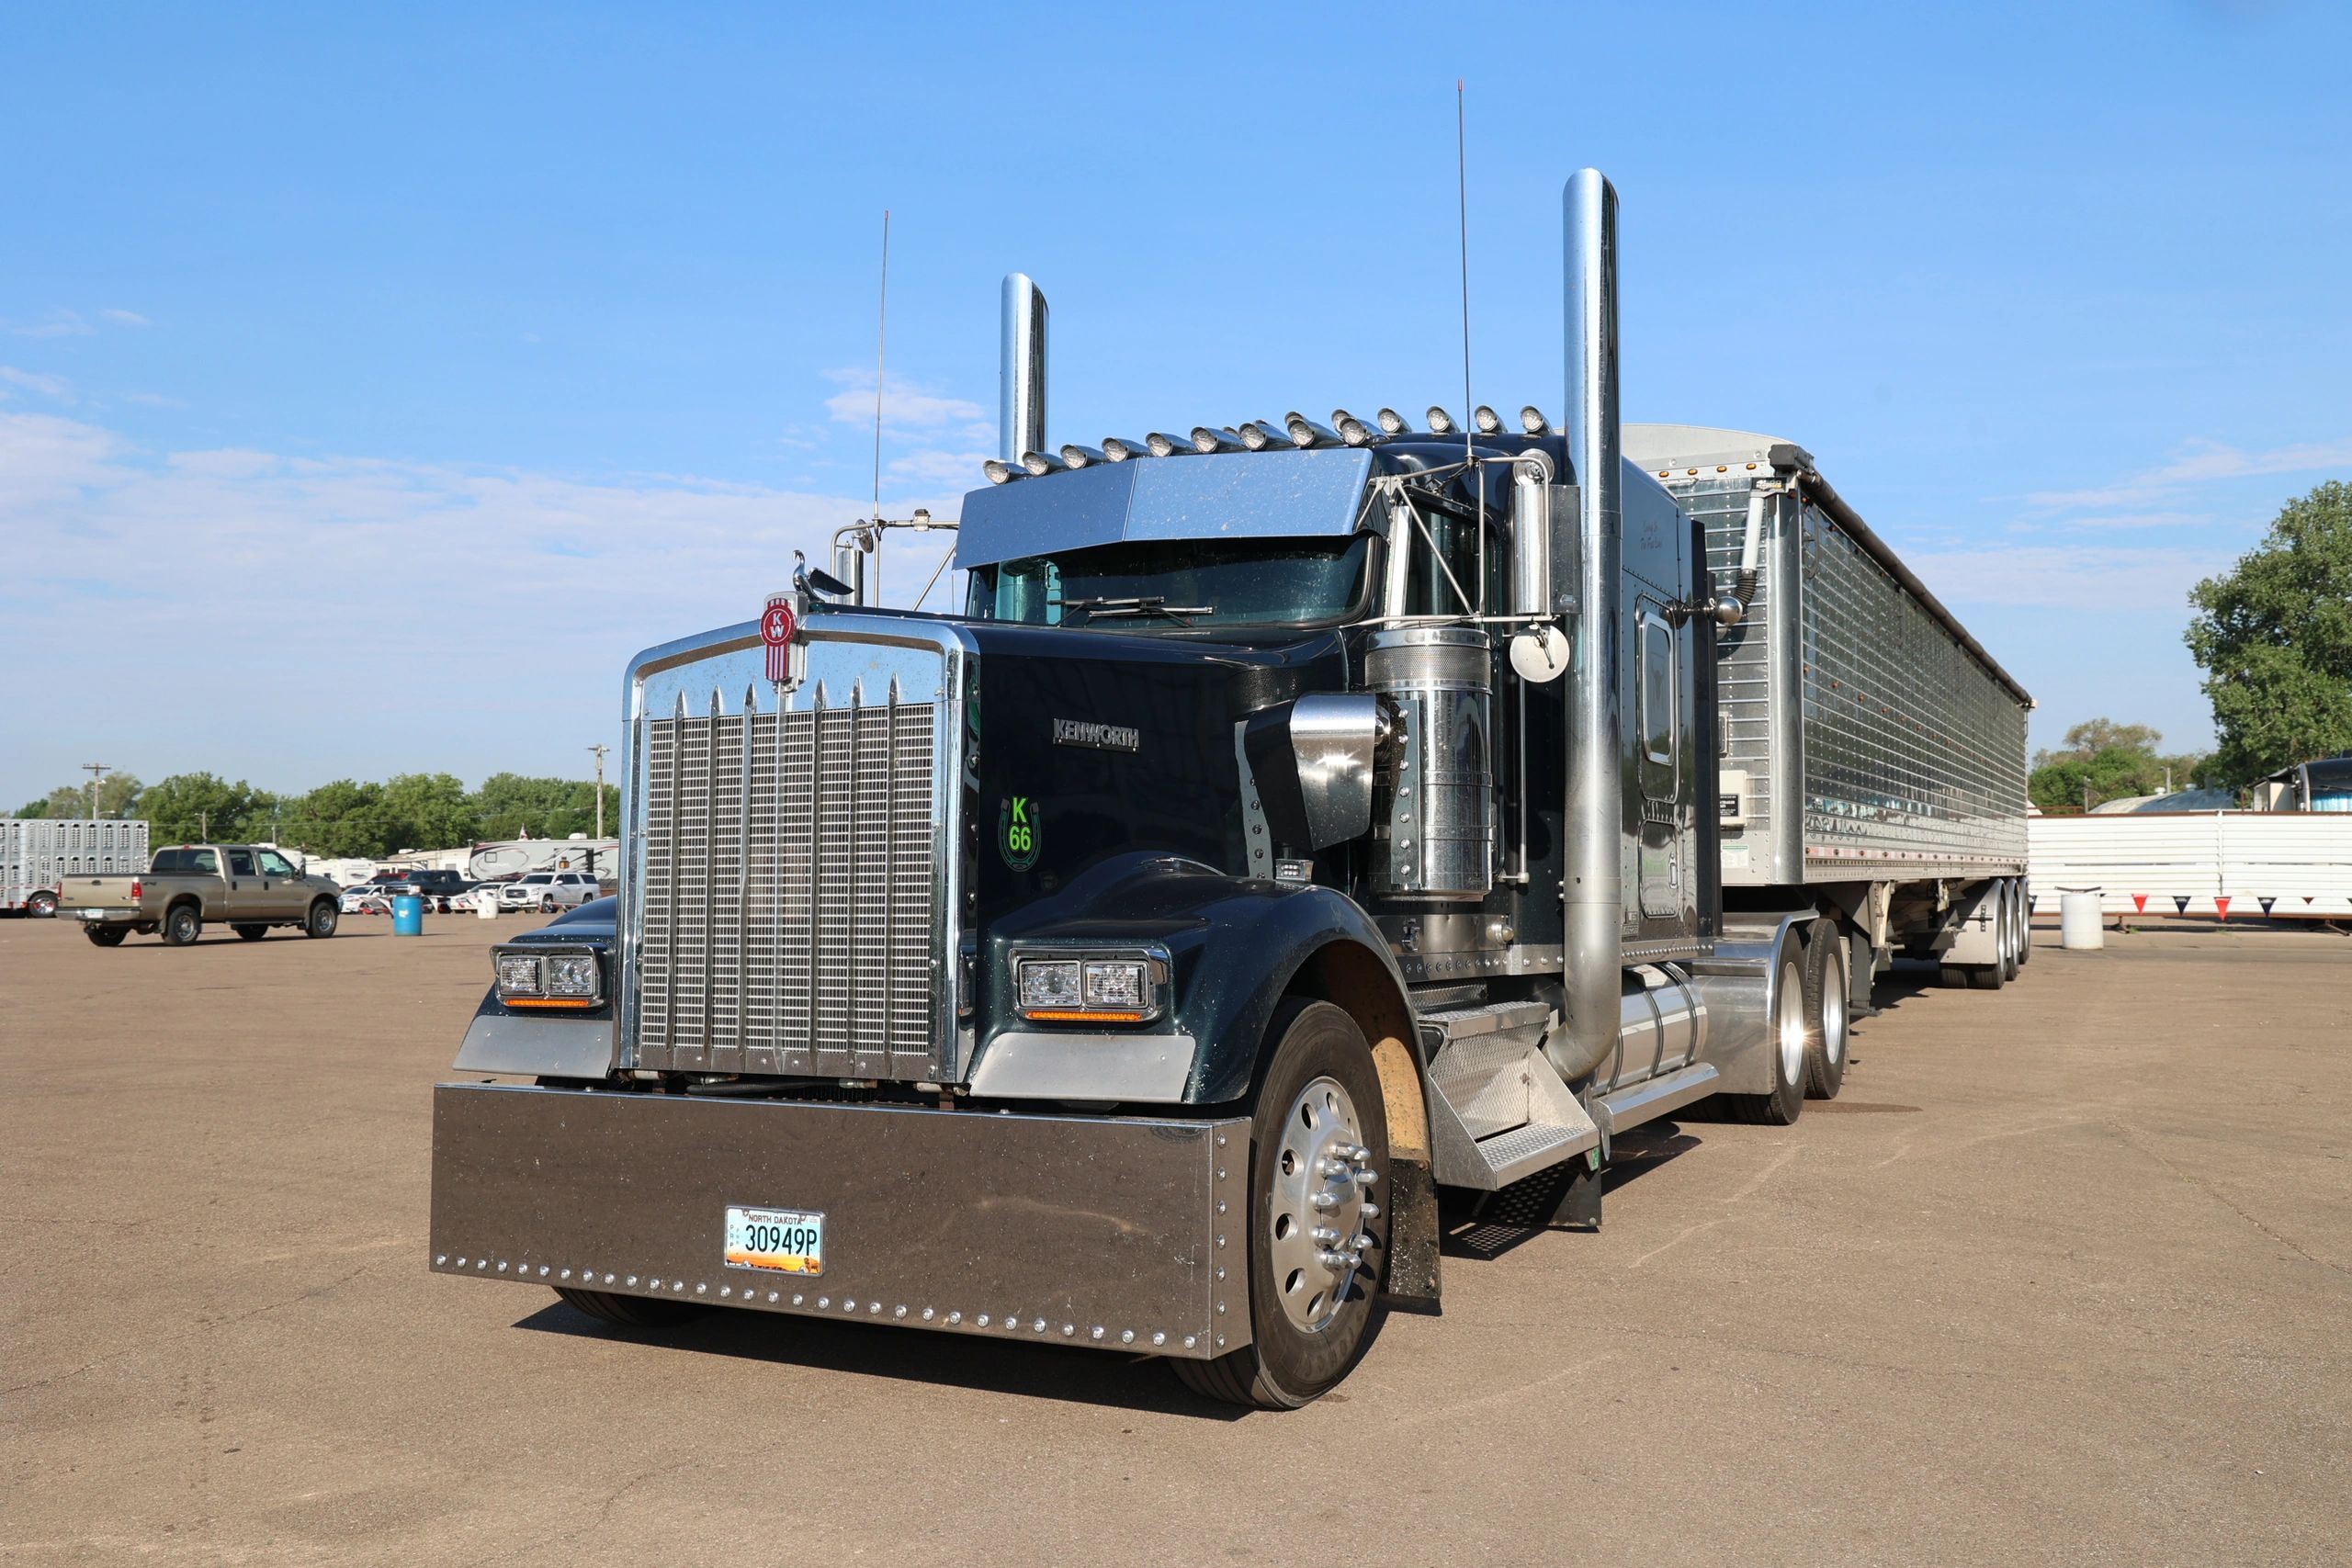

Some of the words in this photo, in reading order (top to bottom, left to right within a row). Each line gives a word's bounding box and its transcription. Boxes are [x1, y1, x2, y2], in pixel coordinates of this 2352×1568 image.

[770, 626, 785, 638] W
[773, 612, 782, 626] K
[1053, 717, 1139, 748] KENWORTH
[1012, 796, 1029, 823] K
[1009, 825, 1031, 852] 66
[748, 1214, 772, 1224] NORTH
[774, 1216, 802, 1225] DAKOTA
[745, 1224, 818, 1256] 30949P
